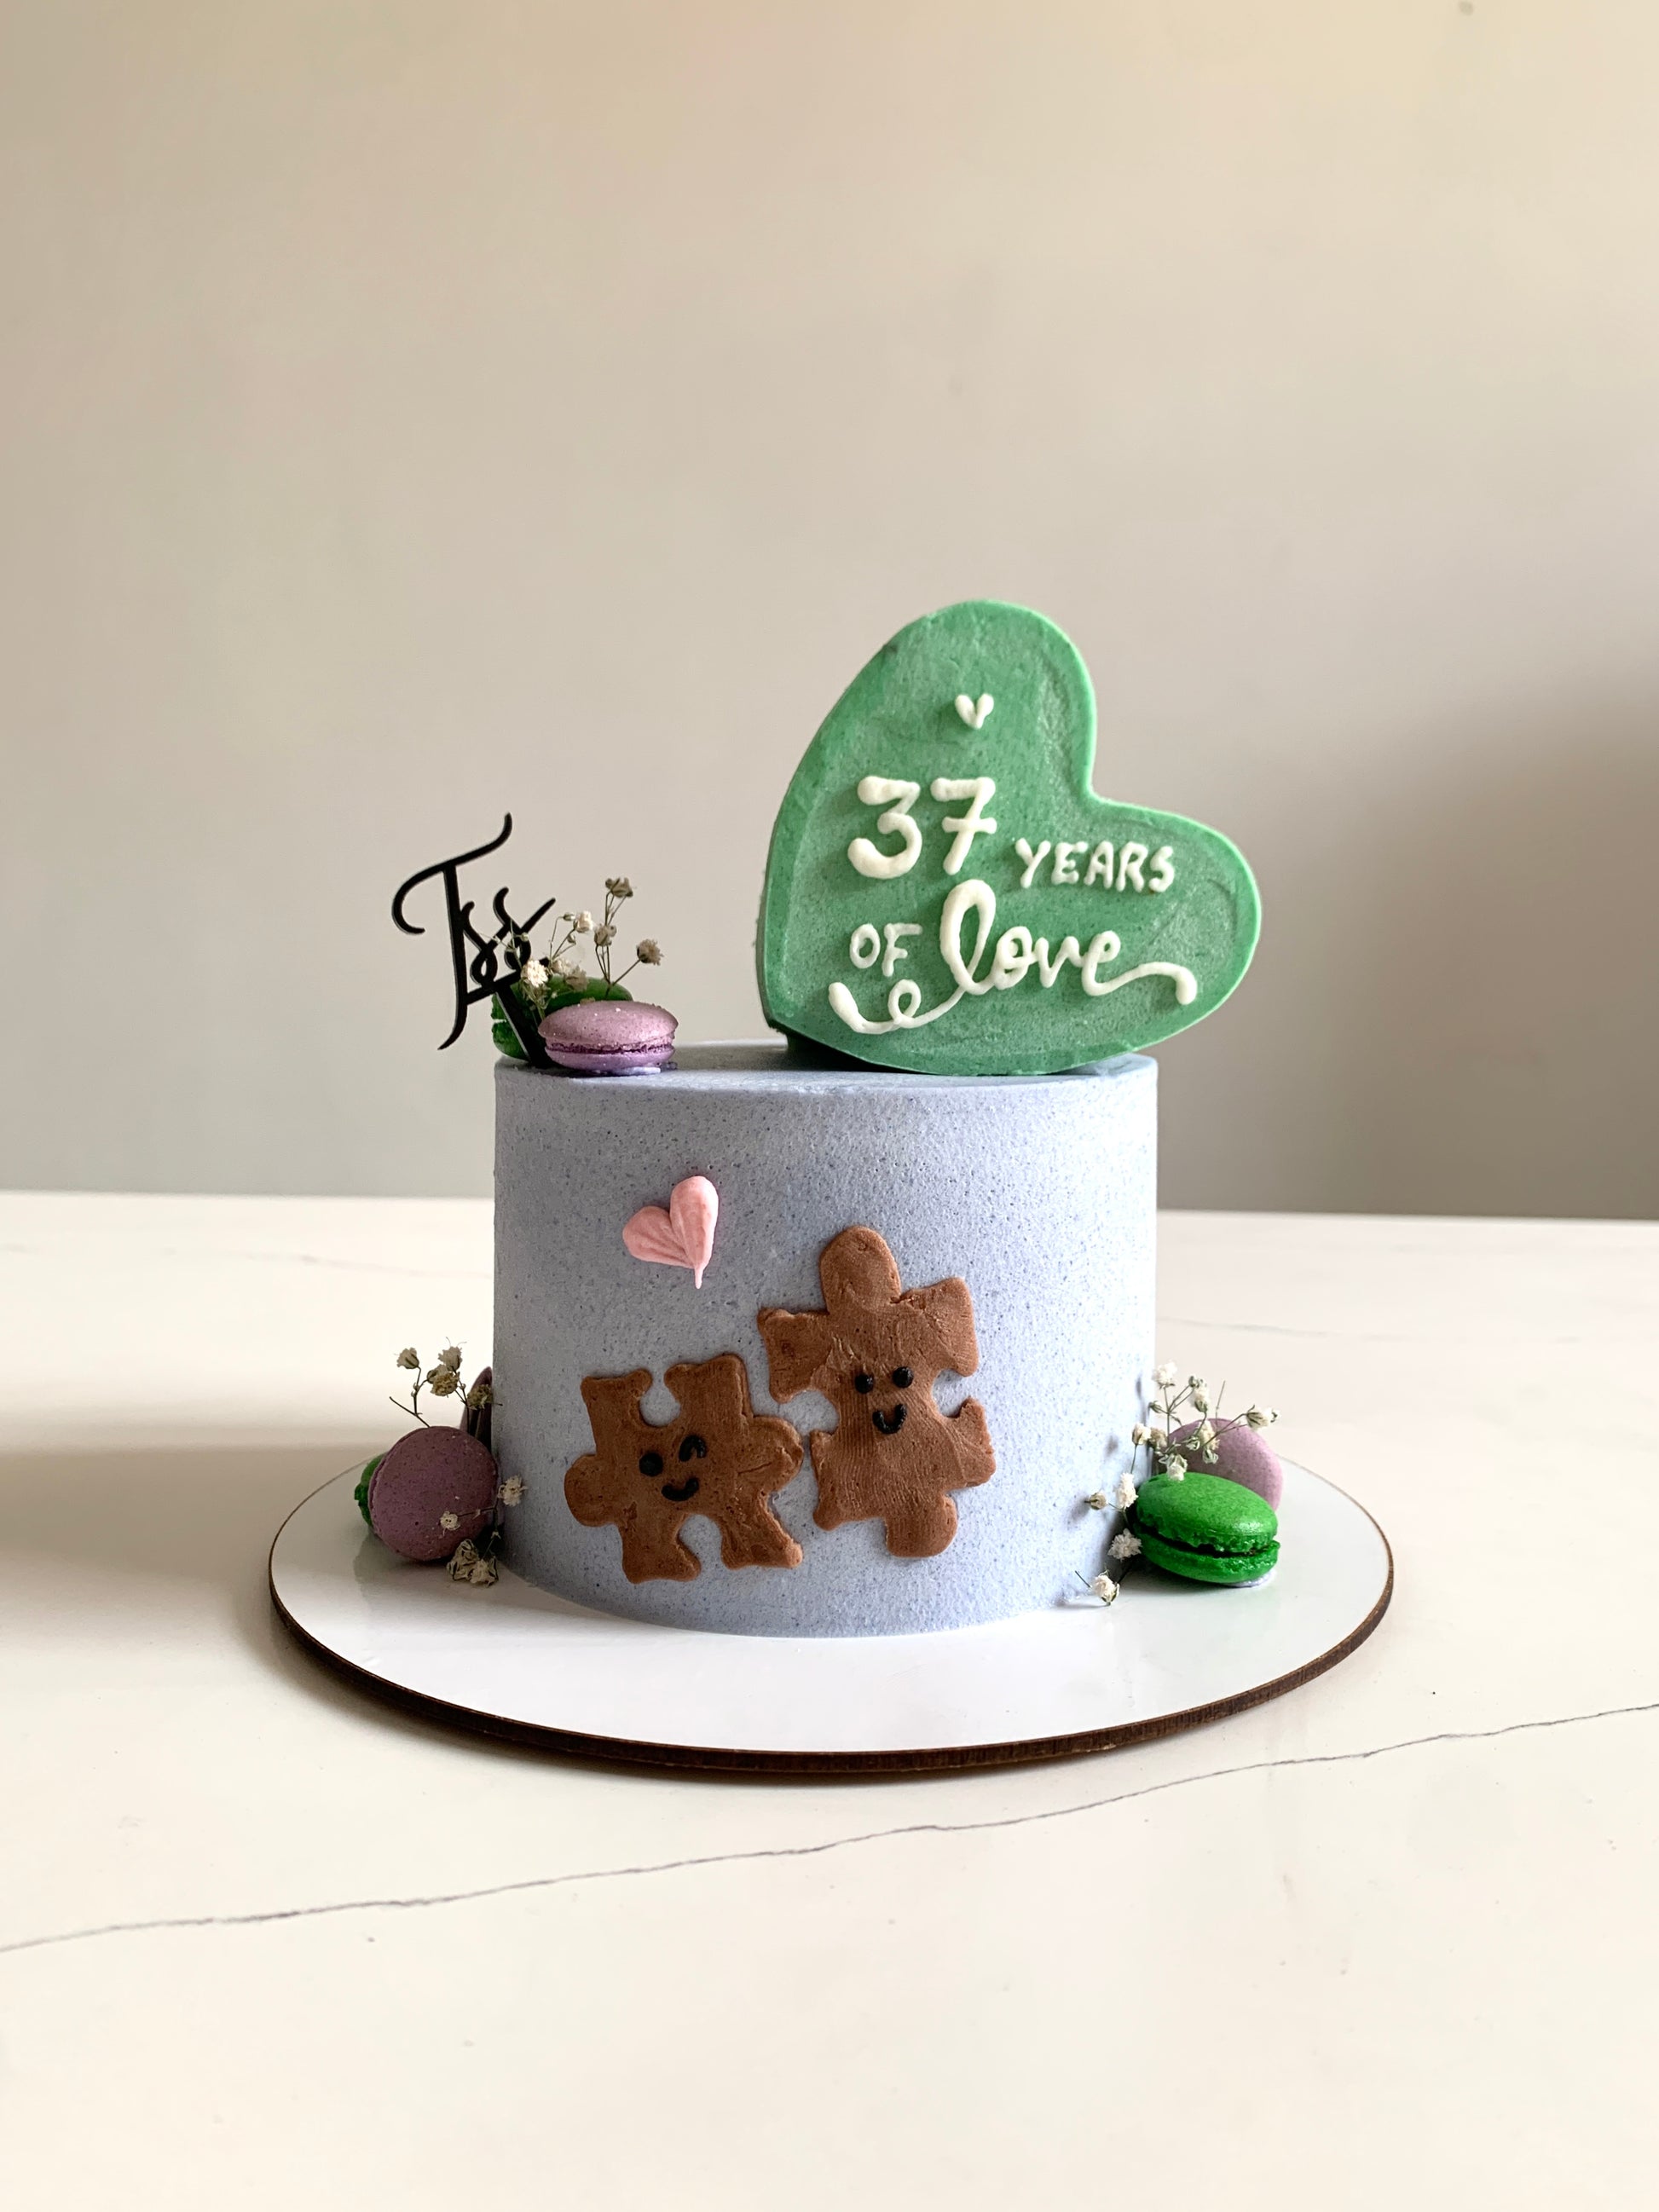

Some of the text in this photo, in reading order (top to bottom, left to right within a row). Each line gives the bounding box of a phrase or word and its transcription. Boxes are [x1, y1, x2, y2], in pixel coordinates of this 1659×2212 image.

[847, 775, 1175, 893] 37 YEARS
[829, 879, 1198, 1035] OF love
